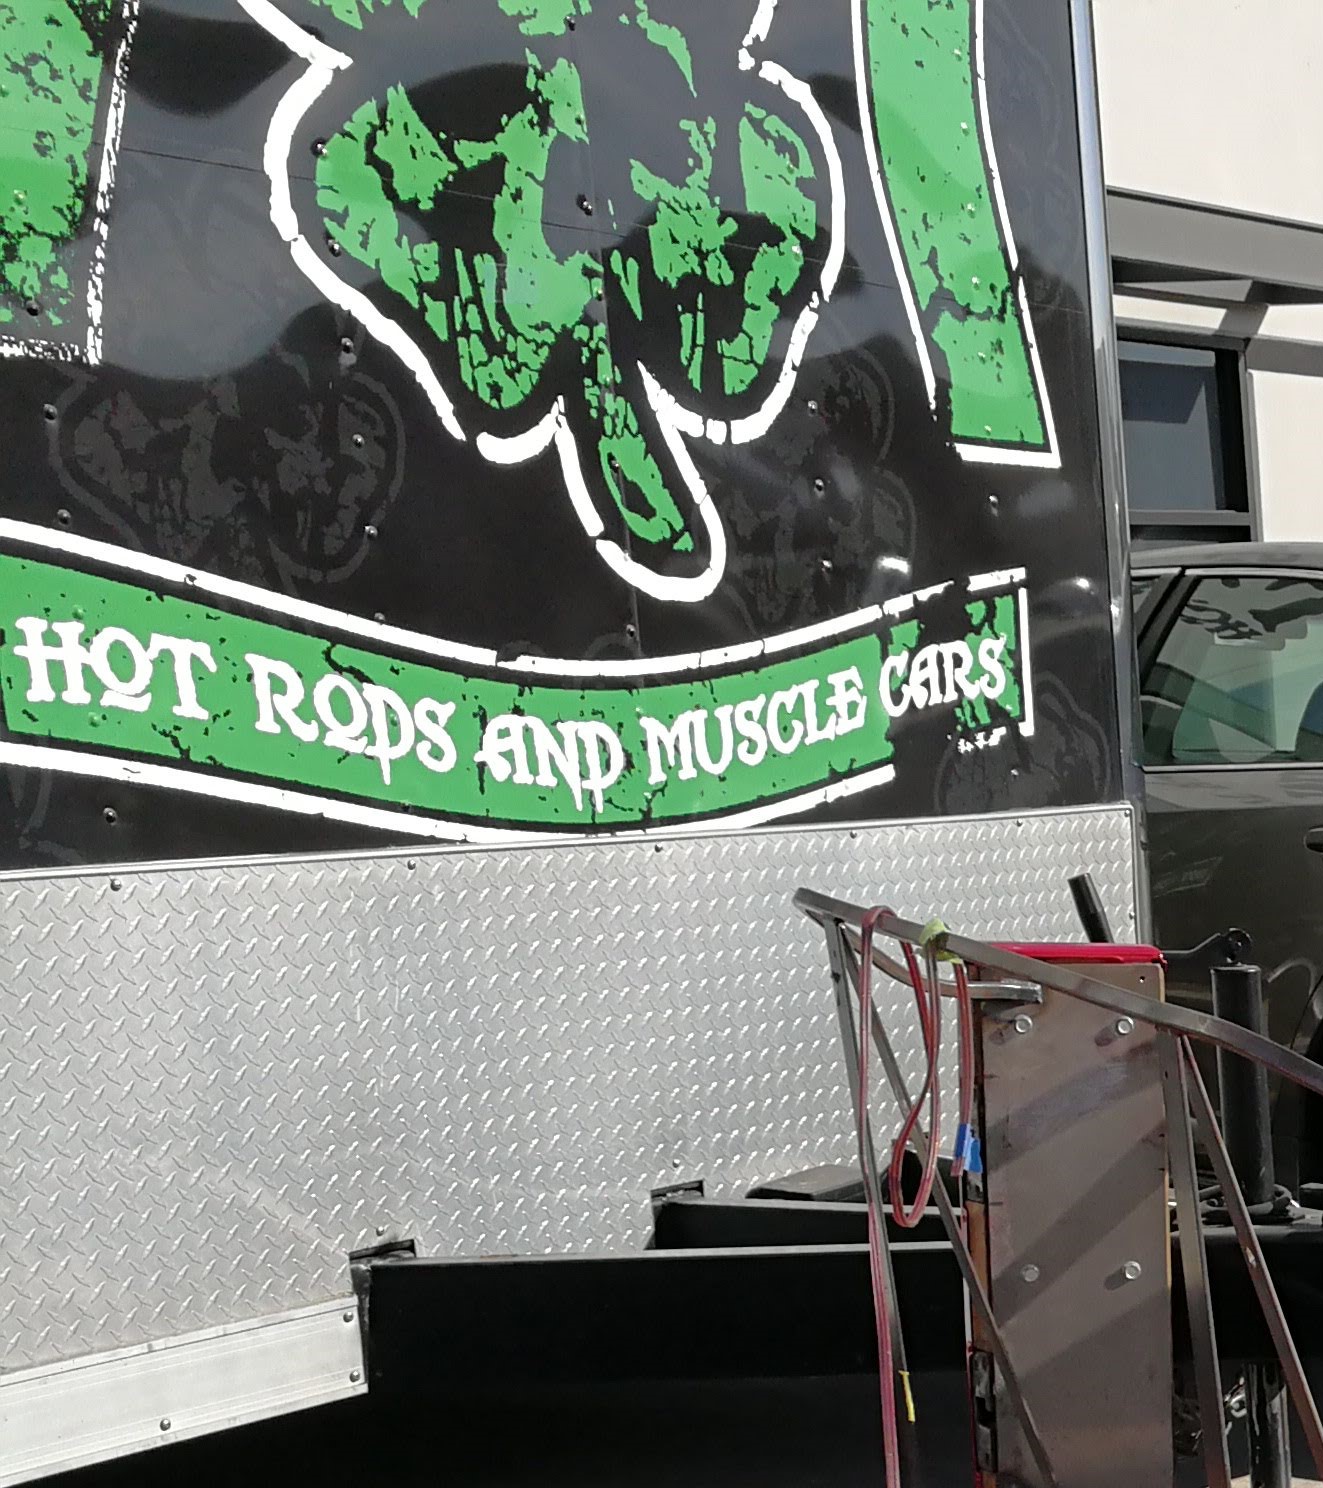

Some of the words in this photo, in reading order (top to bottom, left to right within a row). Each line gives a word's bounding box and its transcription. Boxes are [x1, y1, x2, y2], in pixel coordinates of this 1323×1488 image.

[13, 616, 218, 721] HOT
[244, 652, 458, 786] RODS
[473, 714, 624, 814] AND
[638, 665, 868, 786] MUSCLE
[878, 631, 1008, 719] CARS
